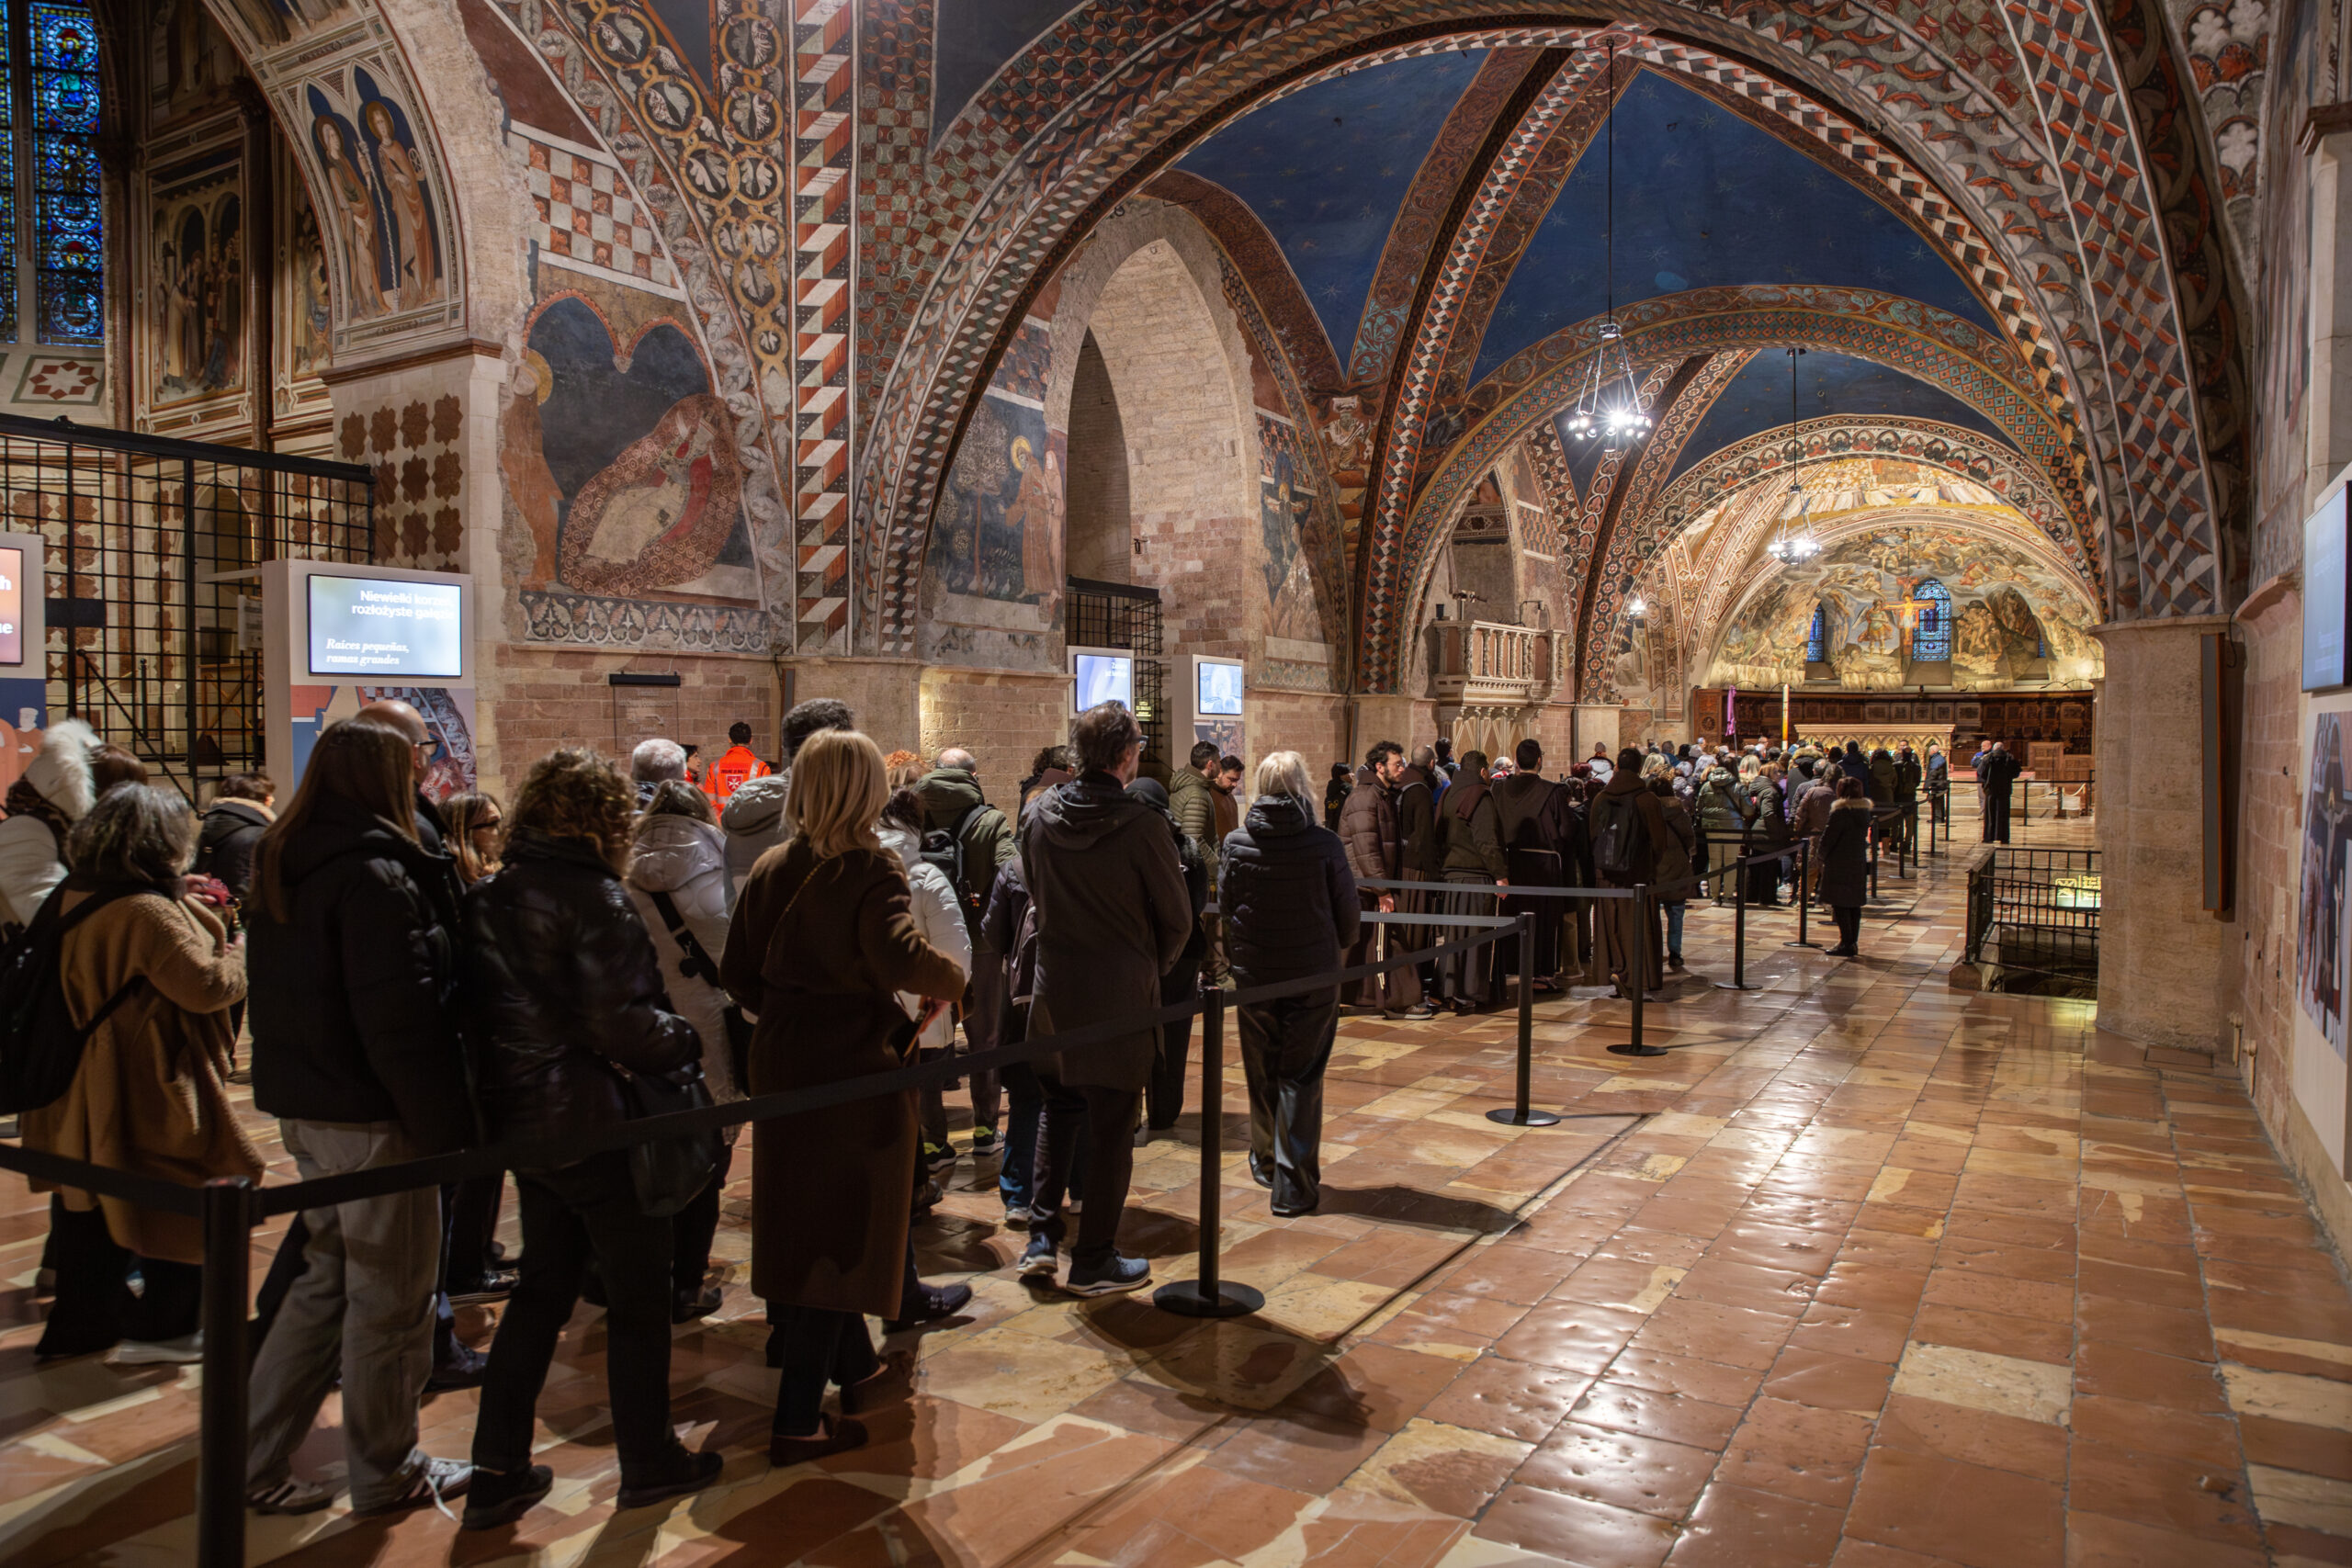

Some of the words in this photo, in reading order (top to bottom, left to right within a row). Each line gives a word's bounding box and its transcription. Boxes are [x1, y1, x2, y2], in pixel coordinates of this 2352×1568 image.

[360, 590, 412, 604] Niewielki
[361, 642, 410, 653] pequeñas,
[326, 655, 358, 663] ramas
[359, 654, 400, 667] grandes
